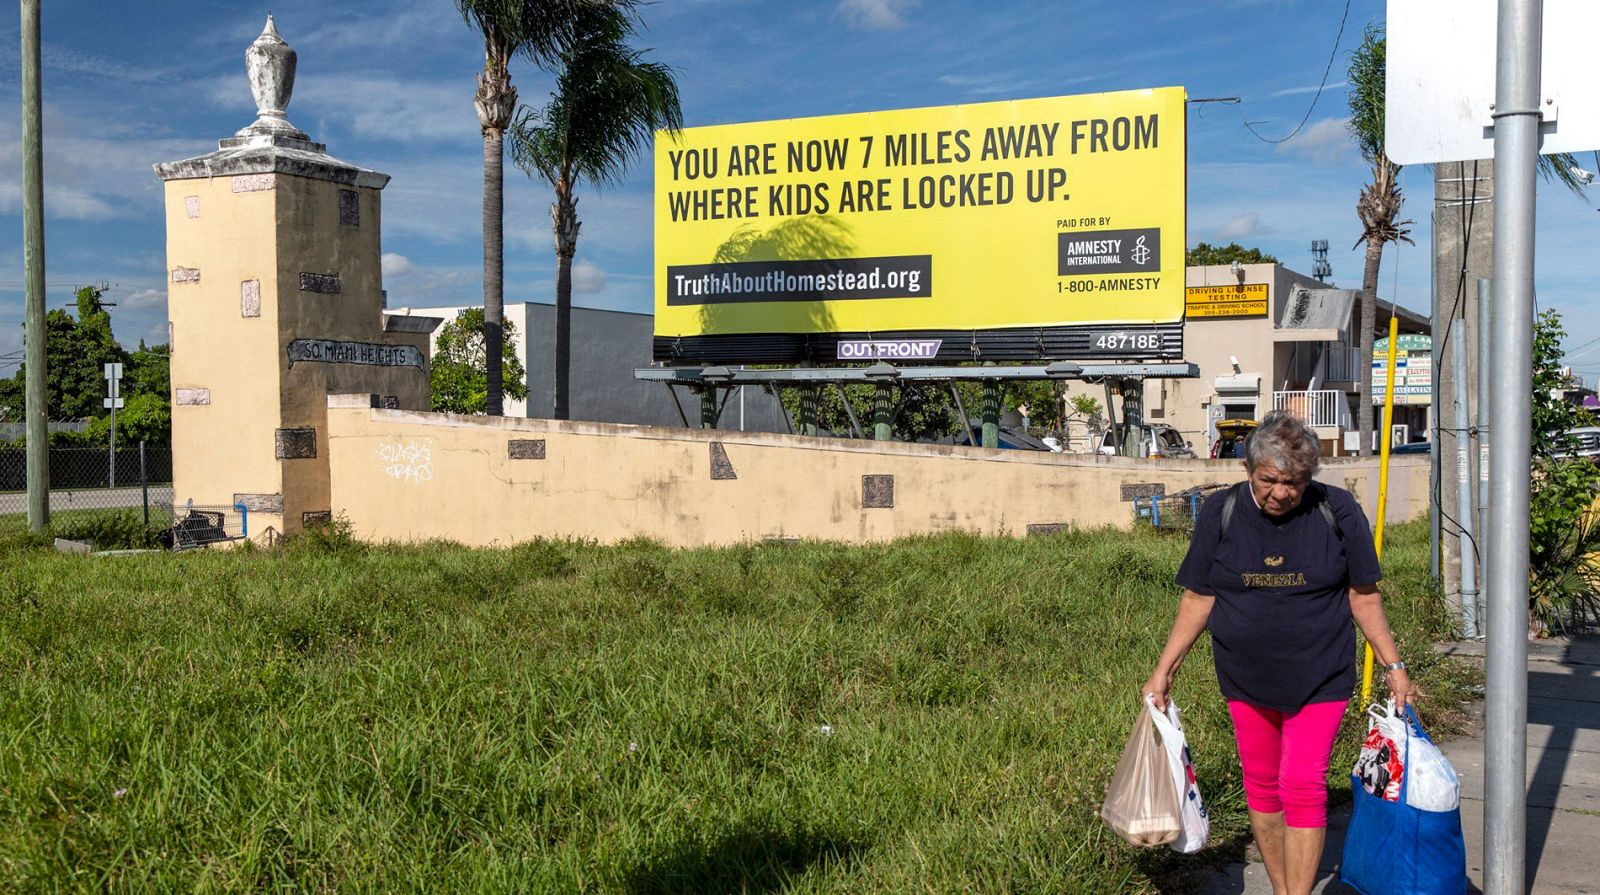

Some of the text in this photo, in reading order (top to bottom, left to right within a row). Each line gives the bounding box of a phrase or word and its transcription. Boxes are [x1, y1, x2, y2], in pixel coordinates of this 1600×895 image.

[668, 114, 1159, 181] YOU ARE NOW 7 MILES AWAY FROM
[668, 167, 1070, 222] WHERE KIDS ARE LOCKED UP.
[1057, 217, 1111, 228] PAID FOR BY
[1067, 240, 1121, 255] AMNESTY
[1067, 255, 1121, 266] INTERNATIONAL
[675, 267, 921, 296] TruthAboutHomestead.org
[1057, 278, 1161, 293] 1-800-AMNESTY
[1189, 285, 1263, 295] DRIVING LICENSE
[1208, 293, 1247, 301] TESTING
[304, 342, 406, 364] SO. MIAMI HEIGHTS
[841, 342, 935, 357] OUTFRONT
[1241, 572, 1307, 587] VENEZIA
